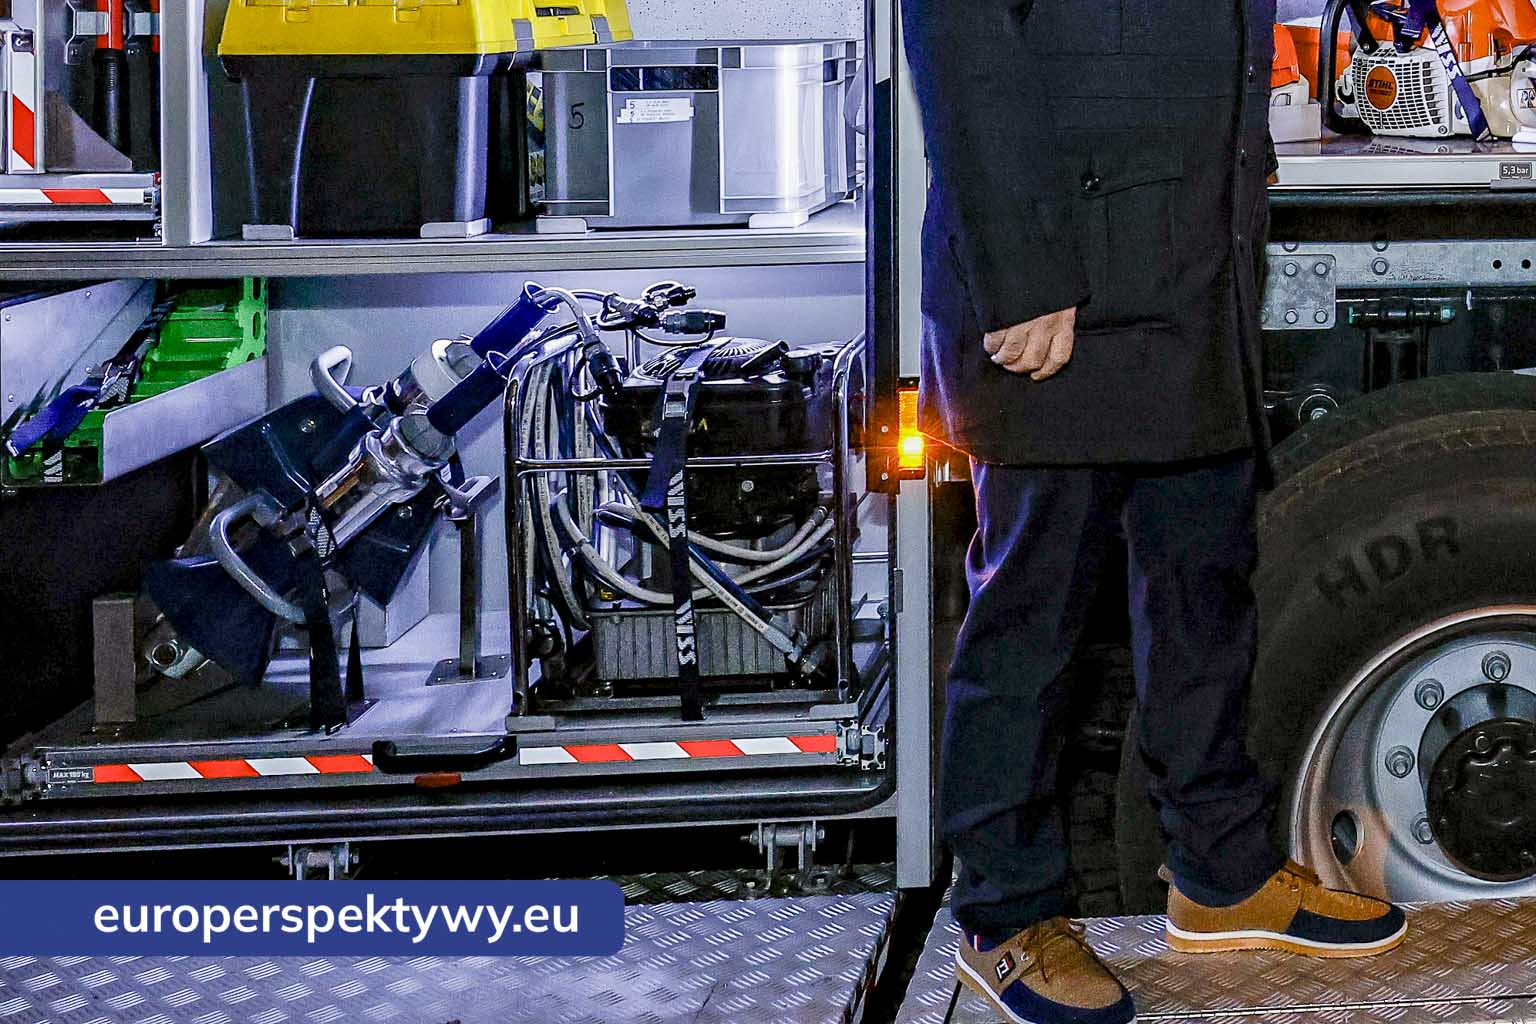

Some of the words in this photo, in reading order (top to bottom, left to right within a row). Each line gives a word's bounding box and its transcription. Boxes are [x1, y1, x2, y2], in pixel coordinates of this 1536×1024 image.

[1368, 78, 1394, 90] STIHL
[568, 102, 585, 129] 5
[1516, 165, 1529, 174] bar
[1314, 516, 1462, 612] HDR
